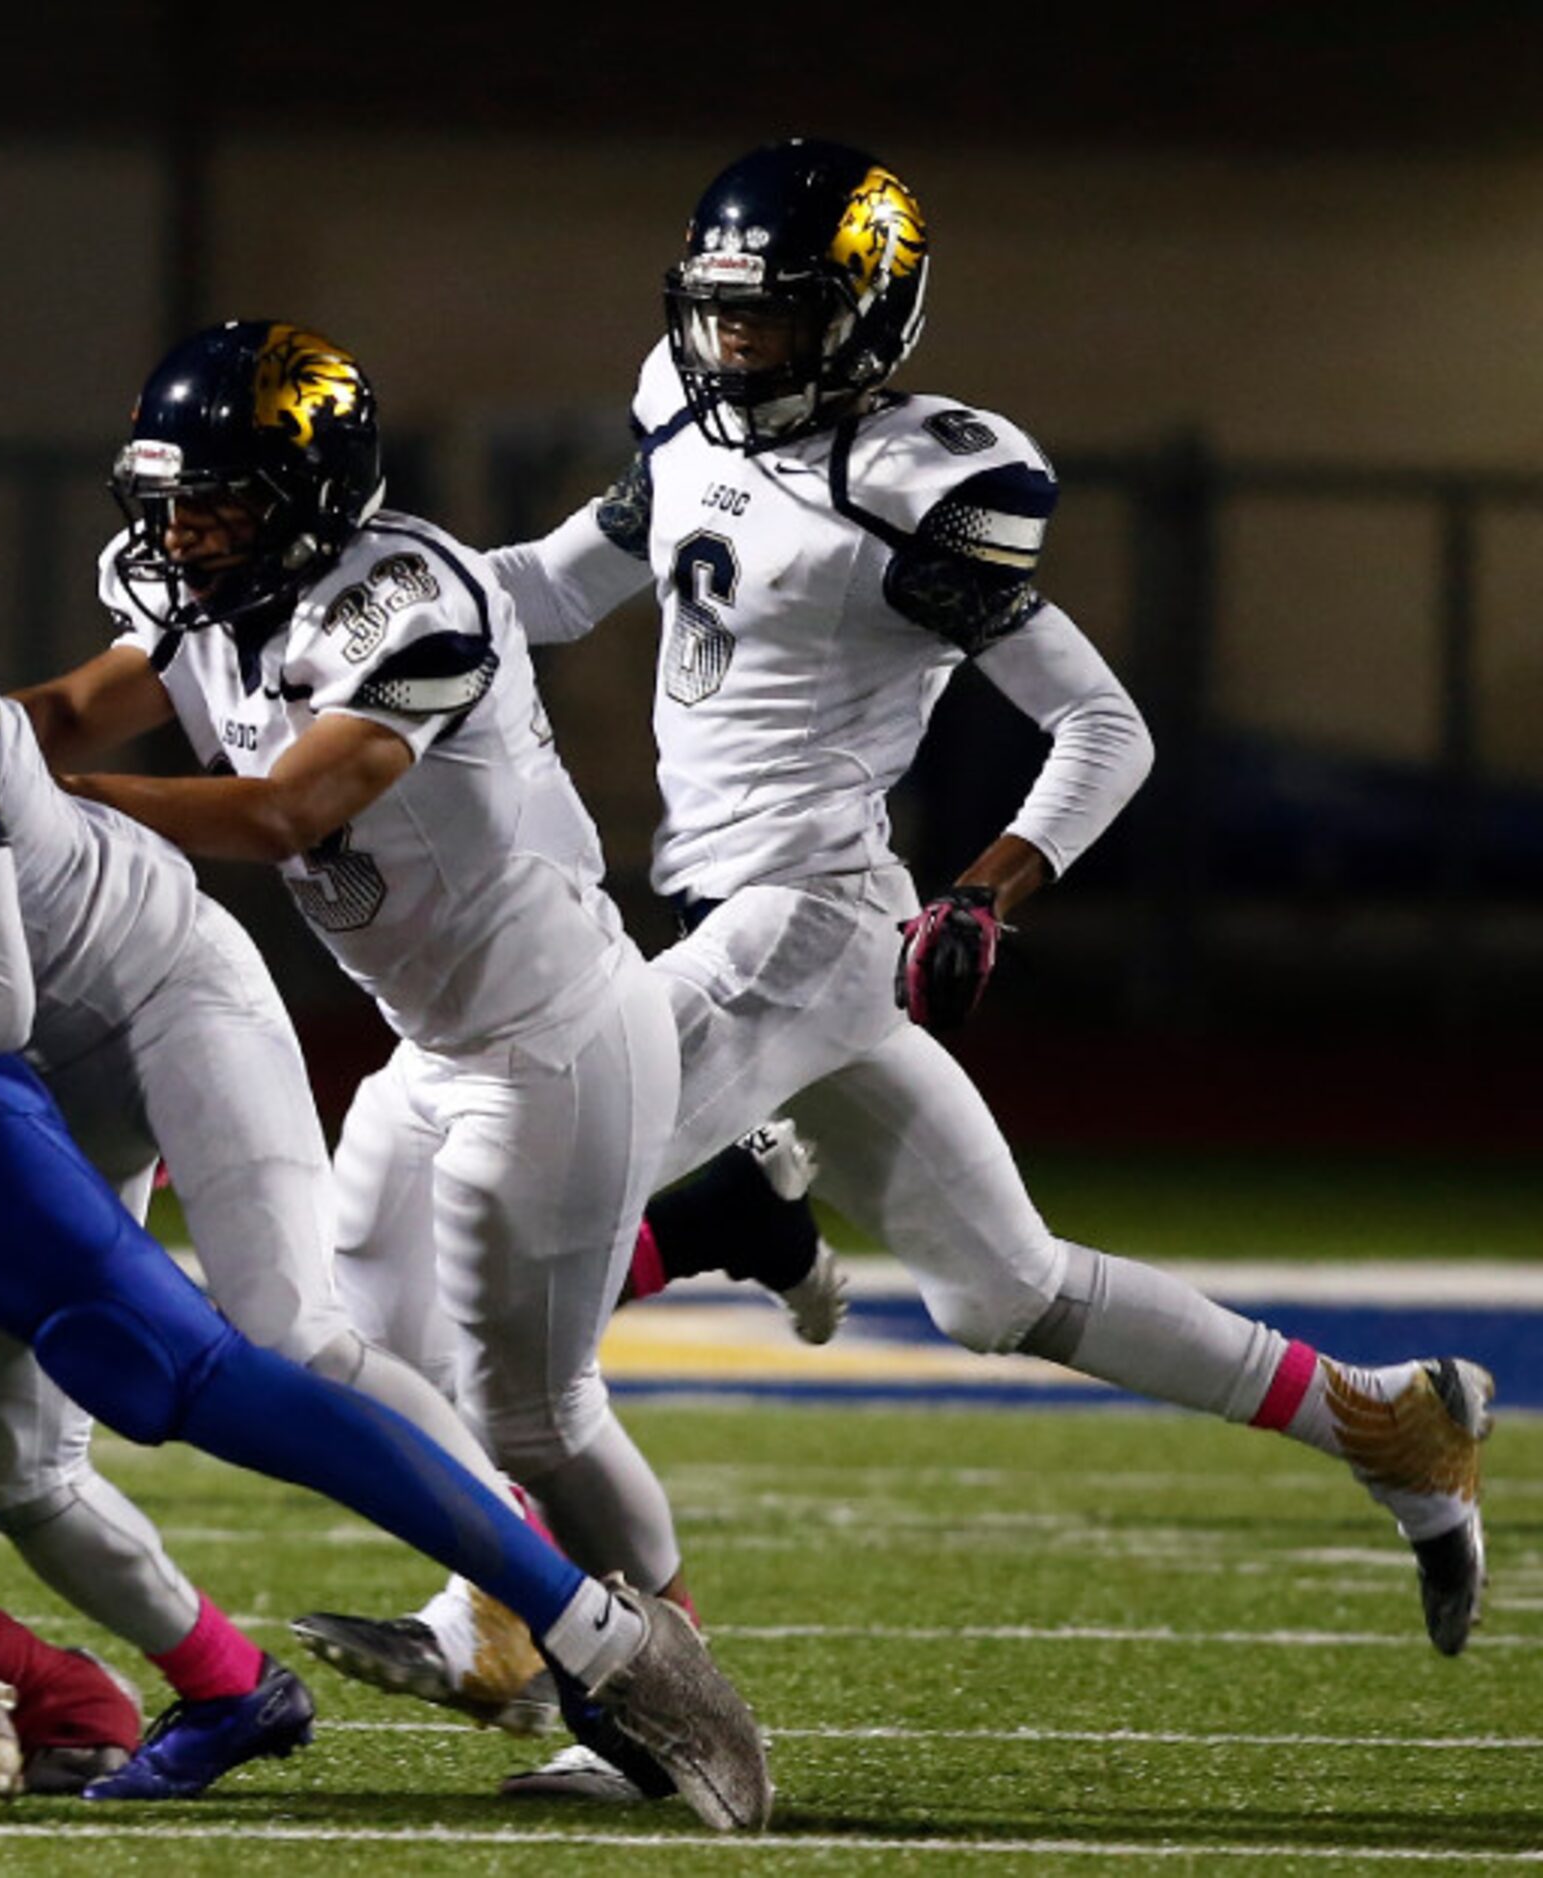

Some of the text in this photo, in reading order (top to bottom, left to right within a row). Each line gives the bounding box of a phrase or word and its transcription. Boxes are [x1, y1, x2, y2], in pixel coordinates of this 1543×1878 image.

[921, 410, 997, 455] 6
[322, 552, 441, 664] 33
[664, 528, 742, 708] 6
